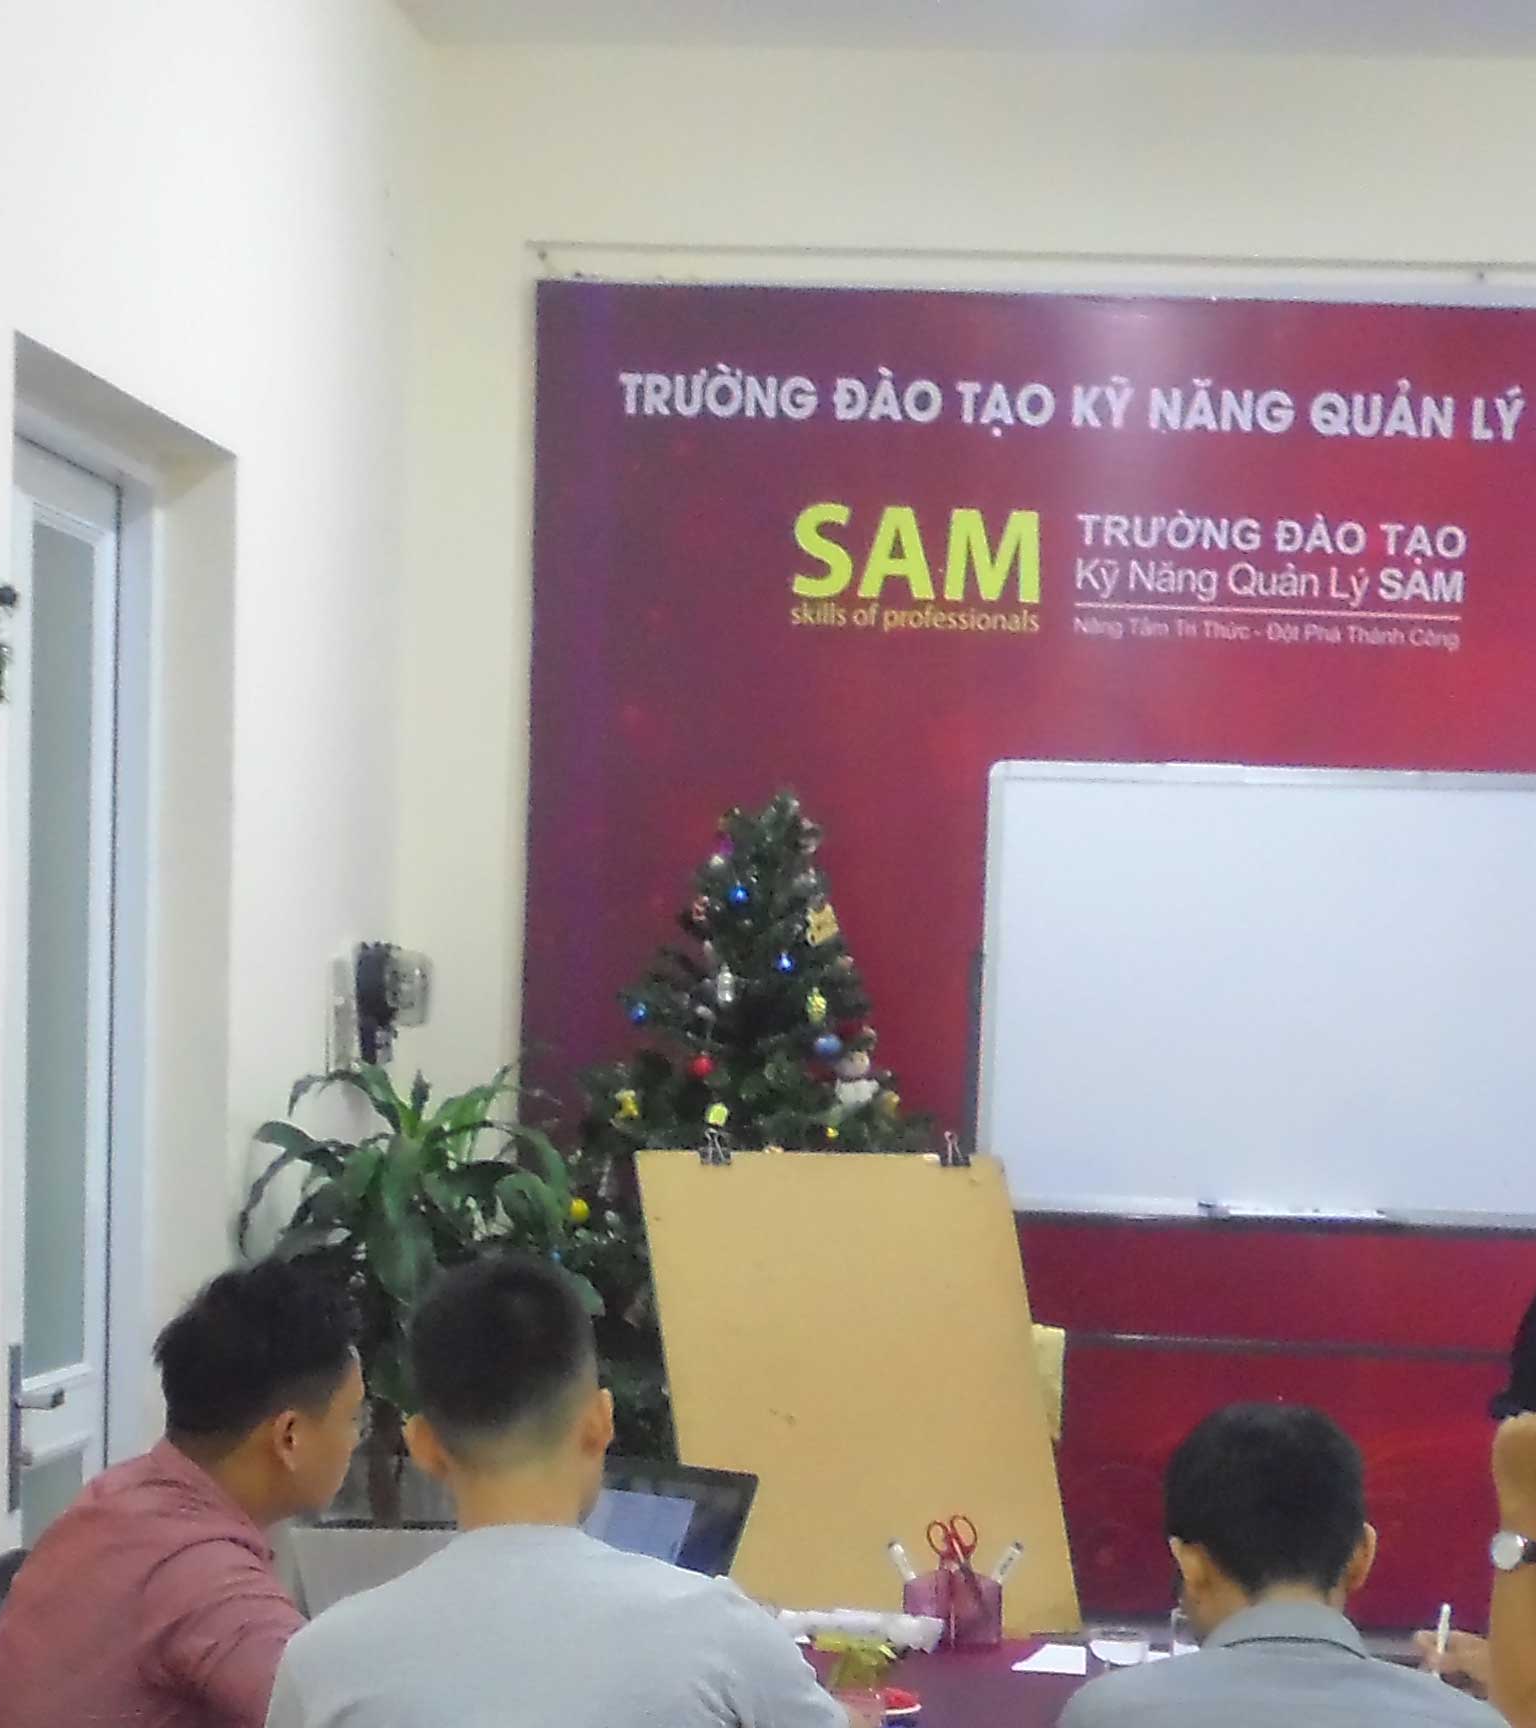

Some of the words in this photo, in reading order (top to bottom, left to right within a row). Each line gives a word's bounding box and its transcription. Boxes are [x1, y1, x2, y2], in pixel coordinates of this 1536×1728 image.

[618, 363, 818, 420] TRƯỜNG
[833, 365, 943, 422] ĐÀO
[955, 381, 1055, 438] TẠO
[1071, 375, 1135, 429] KỸ
[1149, 377, 1295, 433] NĂNG
[1310, 378, 1455, 439] QUẢN
[1471, 385, 1524, 441] LÝ
[792, 502, 1041, 604] SAM
[1076, 510, 1261, 551] TRƯỜNG
[1275, 513, 1366, 556] ĐÀO
[1380, 522, 1466, 565] TẠO
[1074, 557, 1120, 599] Kỹ
[1128, 558, 1218, 602] Năng
[1227, 561, 1320, 600] Quản
[1329, 566, 1369, 608] Lý
[1379, 567, 1465, 603] SAM
[790, 603, 847, 627] skills
[853, 603, 880, 627] of
[882, 604, 1041, 633] professionals
